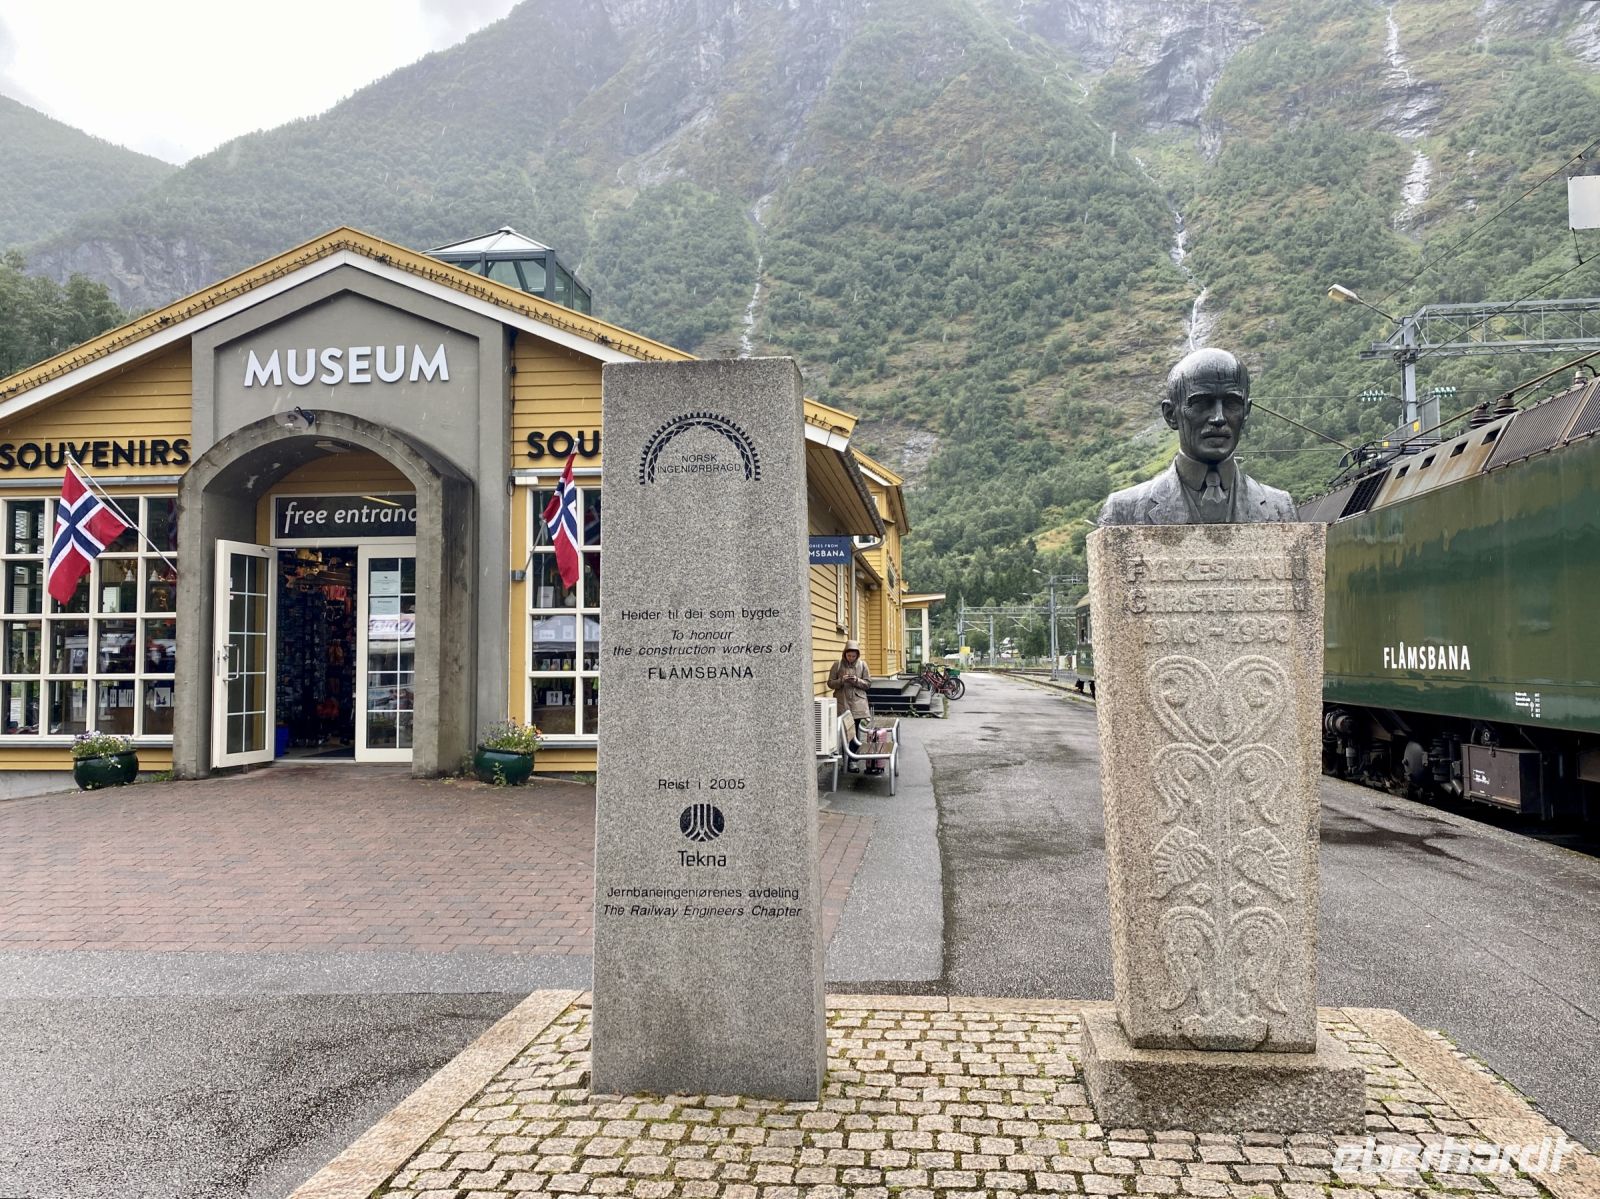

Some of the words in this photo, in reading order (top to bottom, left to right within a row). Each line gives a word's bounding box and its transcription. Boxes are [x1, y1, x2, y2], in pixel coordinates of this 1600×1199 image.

[243, 343, 450, 387] MUSEUM
[0, 438, 190, 470] SOUVENIRS
[527, 430, 600, 469] SOU
[681, 454, 718, 463] NORSK
[657, 463, 741, 474] INGENIØRBRAGD
[284, 502, 328, 534] free
[621, 609, 661, 620] Heider
[668, 609, 678, 620] til
[684, 609, 703, 620] dei
[709, 610, 735, 619] som
[741, 608, 780, 620] bygde
[672, 630, 684, 640] To
[689, 630, 734, 640] honour
[613, 646, 632, 656] the
[638, 645, 716, 656] construction
[722, 643, 773, 654] workers
[779, 643, 794, 653] of
[1383, 642, 1471, 670] FLÅMSBANA
[648, 665, 754, 680] FLÅMSBANA
[658, 779, 690, 790] Reist
[710, 778, 746, 790] 2005
[678, 850, 727, 867] Tekna
[607, 887, 742, 899] Jernbaneingeniørenes
[748, 887, 799, 900] avdeling
[604, 905, 625, 916] The
[630, 905, 678, 917] Railway
[684, 905, 744, 917] Engineers
[751, 905, 802, 917] Chapter
